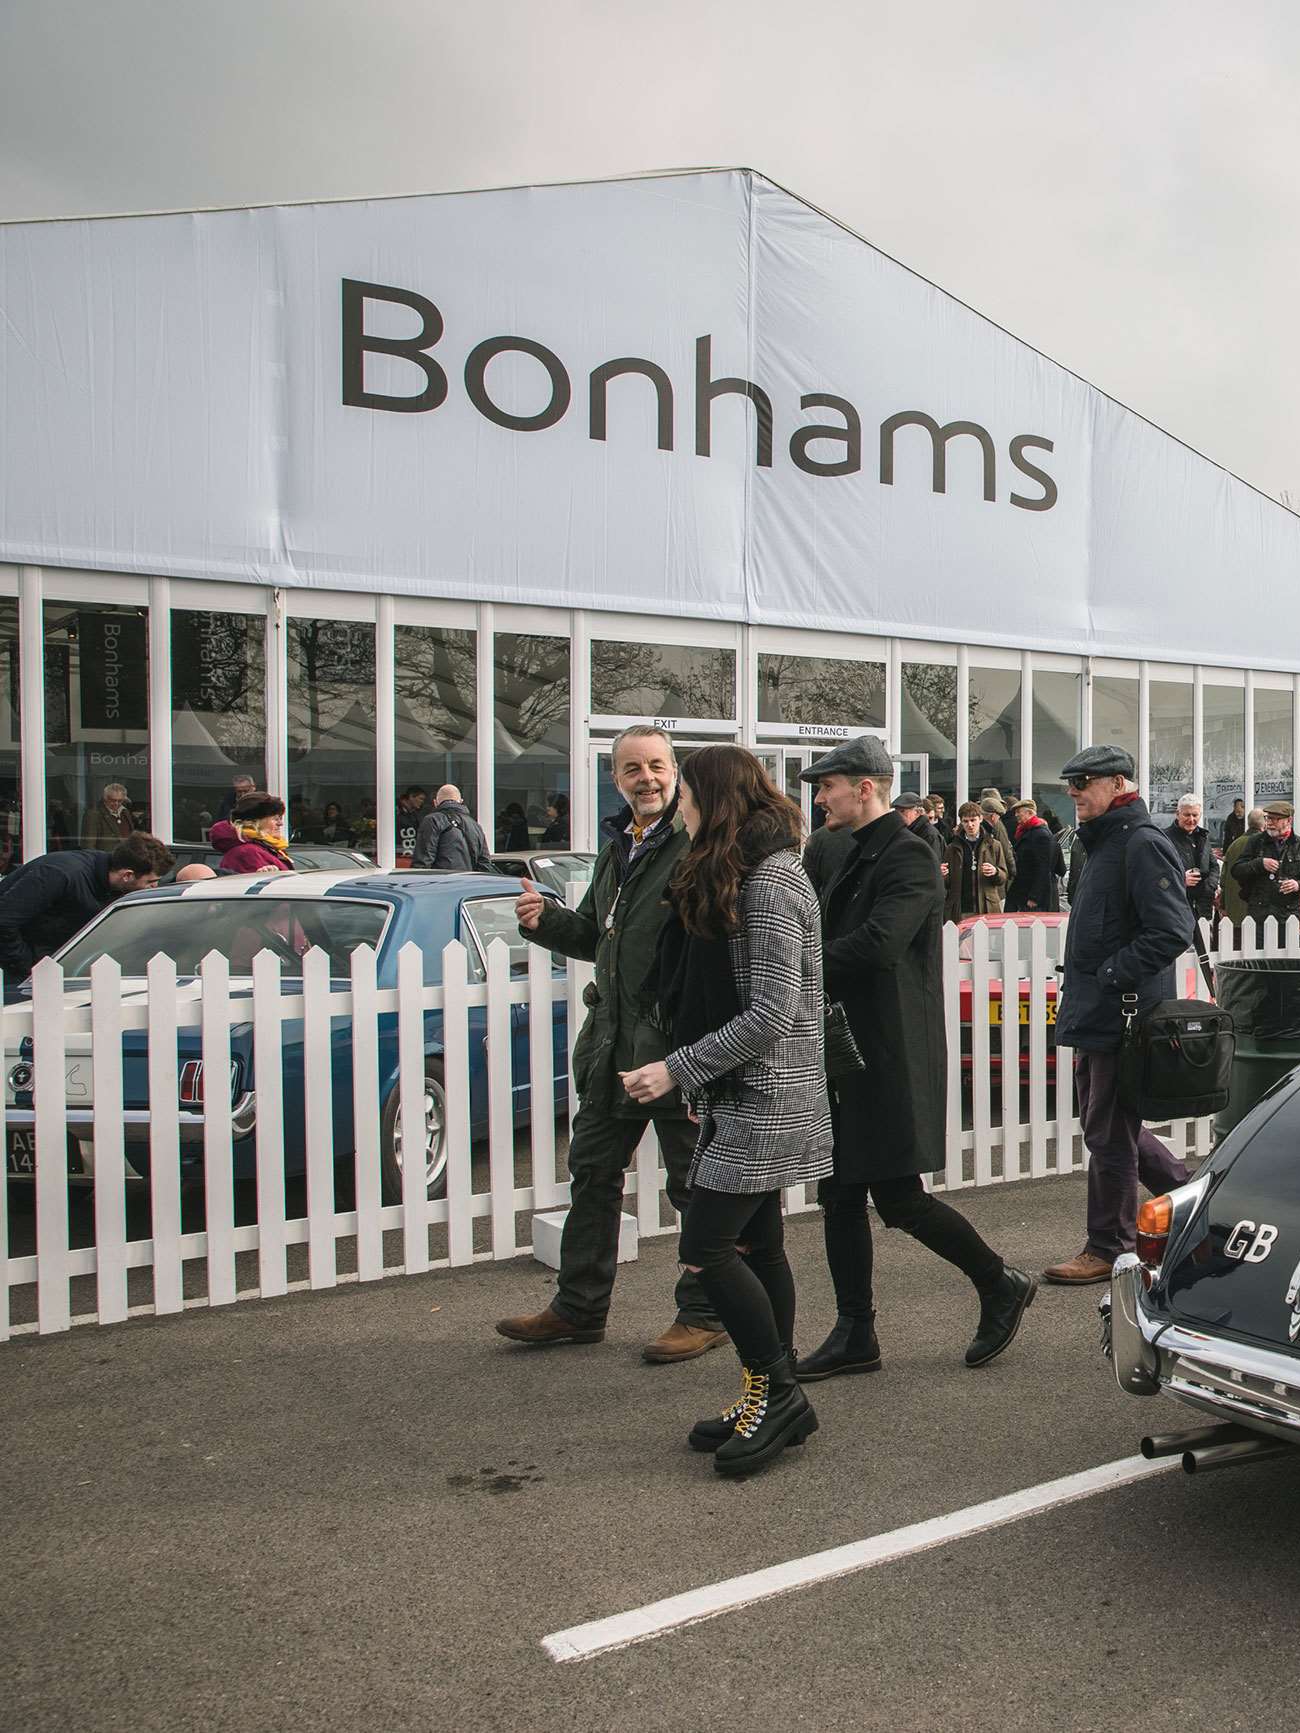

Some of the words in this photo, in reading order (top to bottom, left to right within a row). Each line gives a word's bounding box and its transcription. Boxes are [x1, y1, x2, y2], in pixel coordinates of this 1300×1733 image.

[341, 277, 1059, 512] Bonhams
[104, 623, 127, 719] Bonhams
[653, 719, 678, 729] EXIT
[799, 726, 849, 737] ENTRANCE
[90, 751, 148, 766] Bonha
[1223, 1219, 1279, 1264] GB
